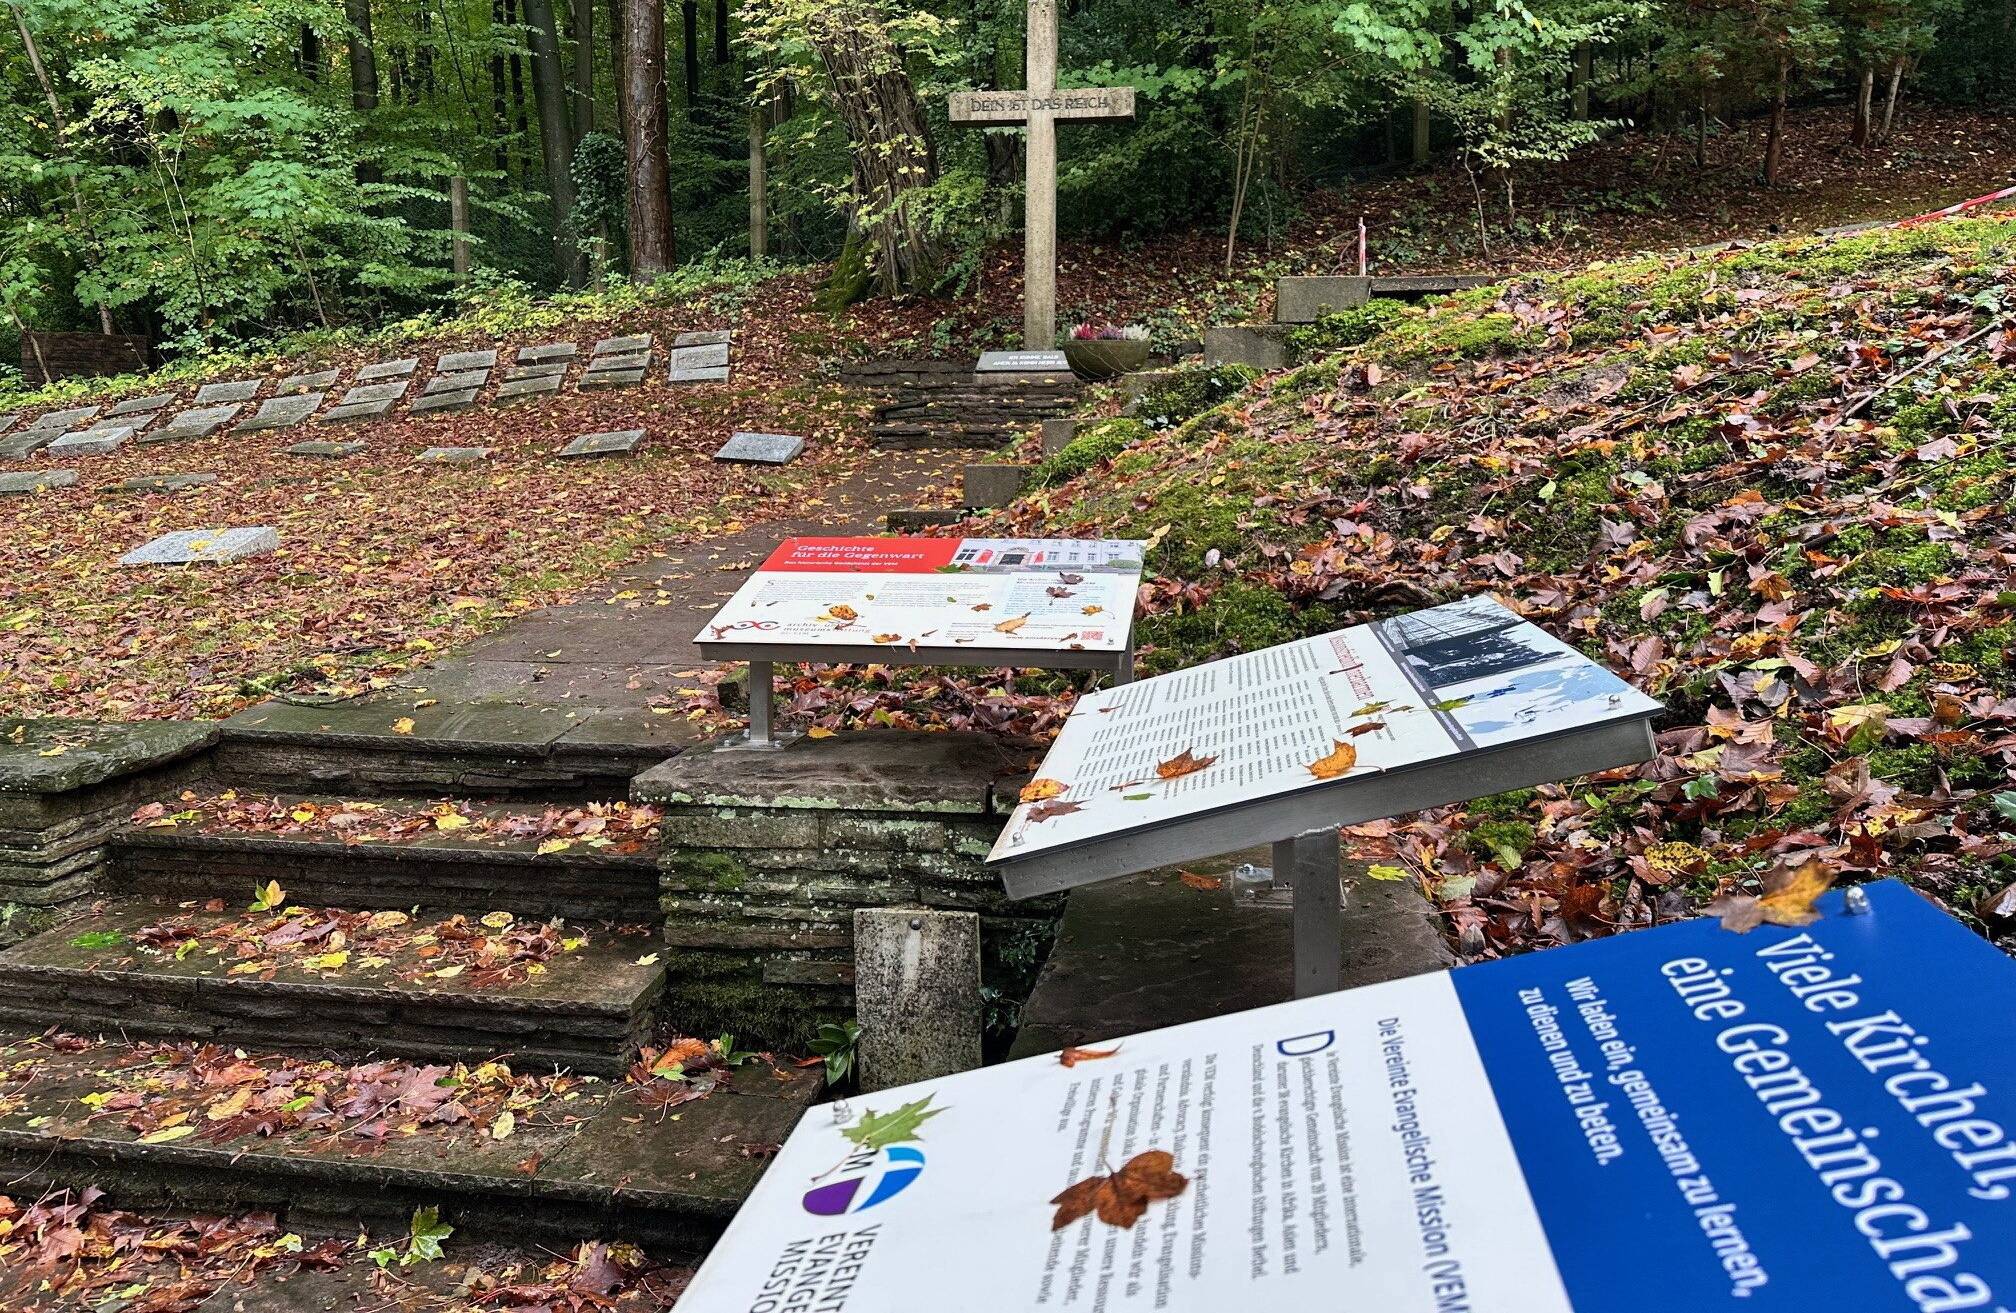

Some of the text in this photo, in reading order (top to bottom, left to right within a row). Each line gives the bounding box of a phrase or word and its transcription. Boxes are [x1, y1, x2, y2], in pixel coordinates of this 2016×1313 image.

[971, 98, 1005, 112] DEIN
[1032, 97, 1060, 111] DAS
[1065, 96, 1109, 110] REICH
[1377, 1017, 1471, 1313] Die Vereinte Evangelische Mission (VEM
[1518, 986, 1624, 1167] zu dienen und zu beten.
[1565, 976, 1769, 1297] Wir laden ein, gemeinsam zu lernen.
[1660, 956, 2012, 1313] eine Gemeinscha
[1755, 932, 2016, 1200] Viele Kirchen,
